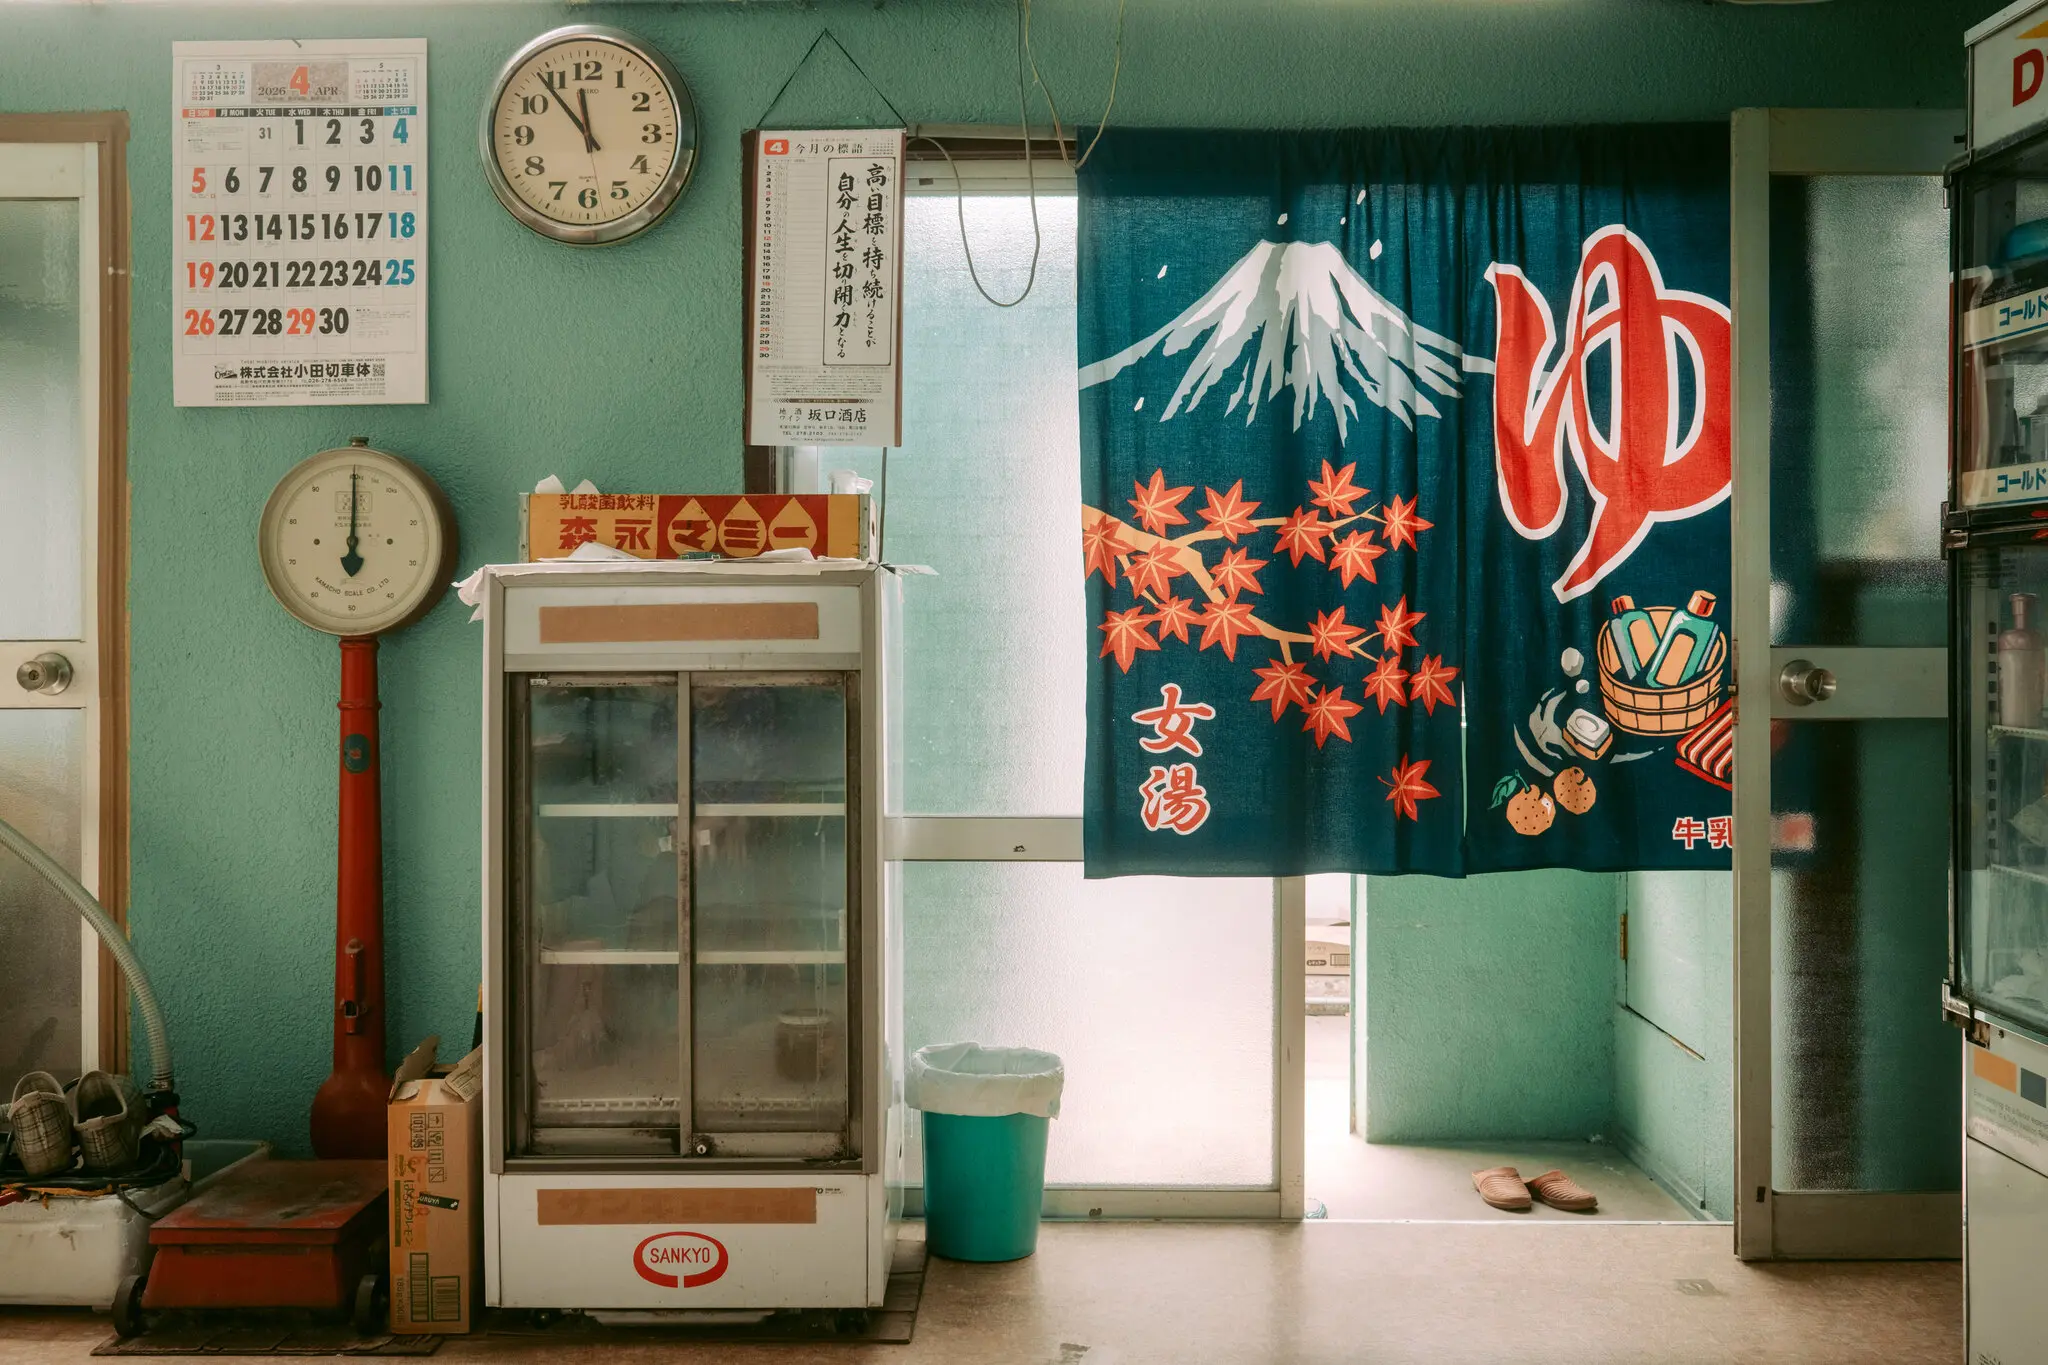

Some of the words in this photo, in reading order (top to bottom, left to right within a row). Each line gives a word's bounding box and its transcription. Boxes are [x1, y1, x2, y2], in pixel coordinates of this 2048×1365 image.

[258, 86, 286, 96] 2026
[289, 66, 310, 95] 4
[315, 86, 339, 96] APR
[545, 70, 568, 89] 11
[572, 61, 603, 81] 12
[615, 69, 626, 88] 1
[520, 94, 549, 115] 10
[632, 92, 650, 112] 2
[188, 110, 196, 118] 日
[220, 109, 227, 117] 月
[229, 109, 244, 117] MON
[256, 109, 264, 117] 火
[266, 109, 276, 117] TUE
[288, 109, 296, 117] 水
[298, 109, 311, 117] WED
[323, 108, 331, 116] 木
[332, 108, 345, 116] THU
[358, 108, 366, 116] 金
[366, 108, 376, 116] FRI
[391, 108, 398, 116] 土
[400, 108, 410, 116] SAT
[259, 127, 272, 140] 31
[295, 119, 304, 145] 1
[326, 119, 341, 145] 2
[359, 118, 375, 144] 3
[393, 118, 409, 144] 4
[514, 125, 535, 146] 9
[642, 123, 662, 144] 3
[770, 142, 783, 153] 4
[795, 143, 863, 154] 今月の標語
[524, 156, 545, 176] 8
[629, 155, 652, 174] 4
[191, 168, 206, 193] 5
[225, 167, 240, 193] 6
[259, 167, 274, 192] 7
[292, 166, 307, 192] 8
[325, 165, 341, 192] 9
[354, 165, 382, 192] 10
[388, 165, 412, 191] 11
[548, 181, 568, 200] 7
[578, 188, 598, 208] 6
[610, 181, 629, 200] 5
[186, 214, 215, 241] 12
[220, 214, 248, 241] 13
[254, 214, 282, 240] 14
[288, 214, 315, 240] 15
[321, 213, 349, 240] 16
[354, 213, 383, 239] 17
[388, 212, 415, 239] 18
[186, 262, 214, 288] 19
[218, 261, 249, 288] 20
[252, 261, 280, 288] 21
[286, 261, 316, 287] 22
[319, 260, 349, 287] 23
[352, 260, 382, 286] 24
[385, 259, 415, 286] 25
[184, 309, 215, 335] 26
[218, 309, 249, 335] 27
[252, 309, 282, 335] 28
[286, 308, 316, 335] 29
[319, 308, 349, 334] 30
[1999, 296, 2048, 327] コールド
[239, 363, 371, 379] 株式会社小田切車体
[808, 408, 867, 423] 坂口酒店
[1484, 223, 1732, 604] ゆ
[1997, 468, 2047, 493] コールド
[559, 494, 655, 511] 乳酸菌飲料
[559, 517, 652, 551] 森永
[672, 519, 810, 550] マミー
[1131, 683, 1216, 835] 女湯
[1672, 816, 1732, 850] 牛乳
[650, 1247, 711, 1264] SANKYO
